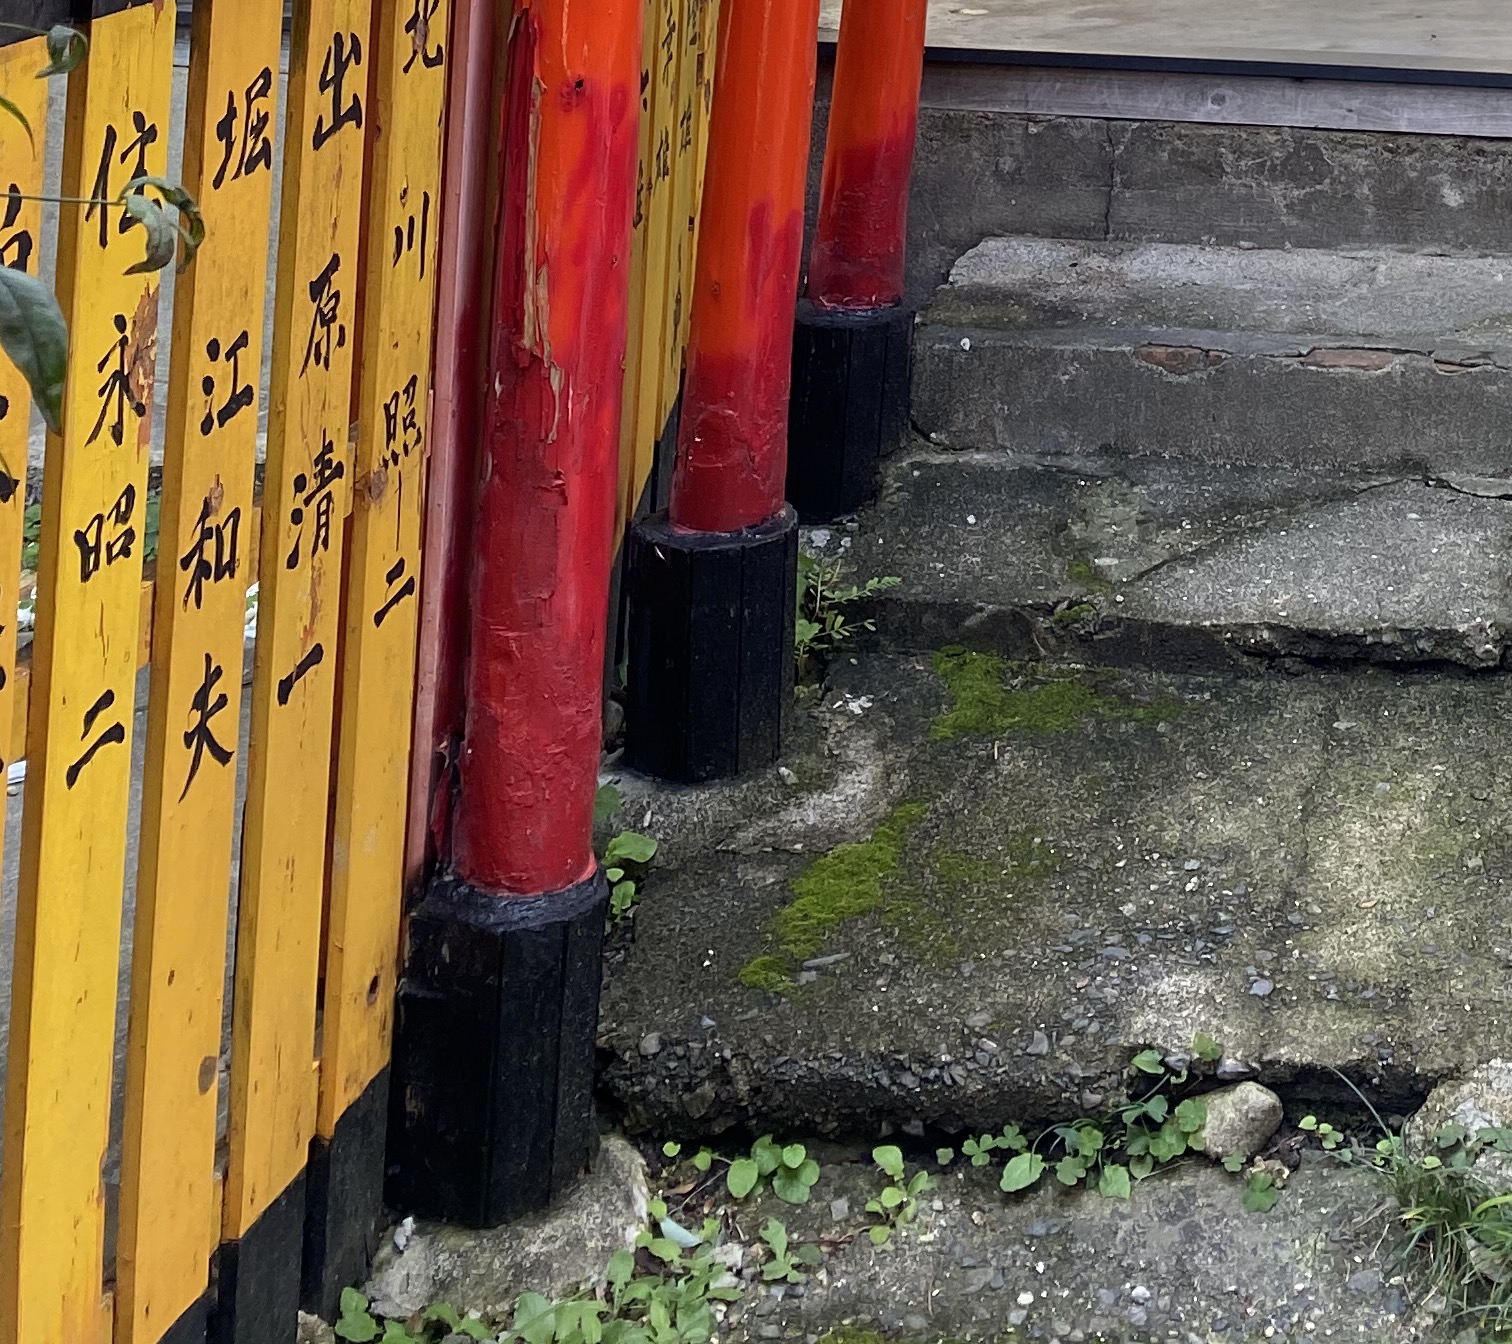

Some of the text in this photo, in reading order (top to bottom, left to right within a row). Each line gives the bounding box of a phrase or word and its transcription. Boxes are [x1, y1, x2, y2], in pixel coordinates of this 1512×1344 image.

[178, 66, 272, 804] 堀江和夫
[279, 30, 362, 706] 出原清一
